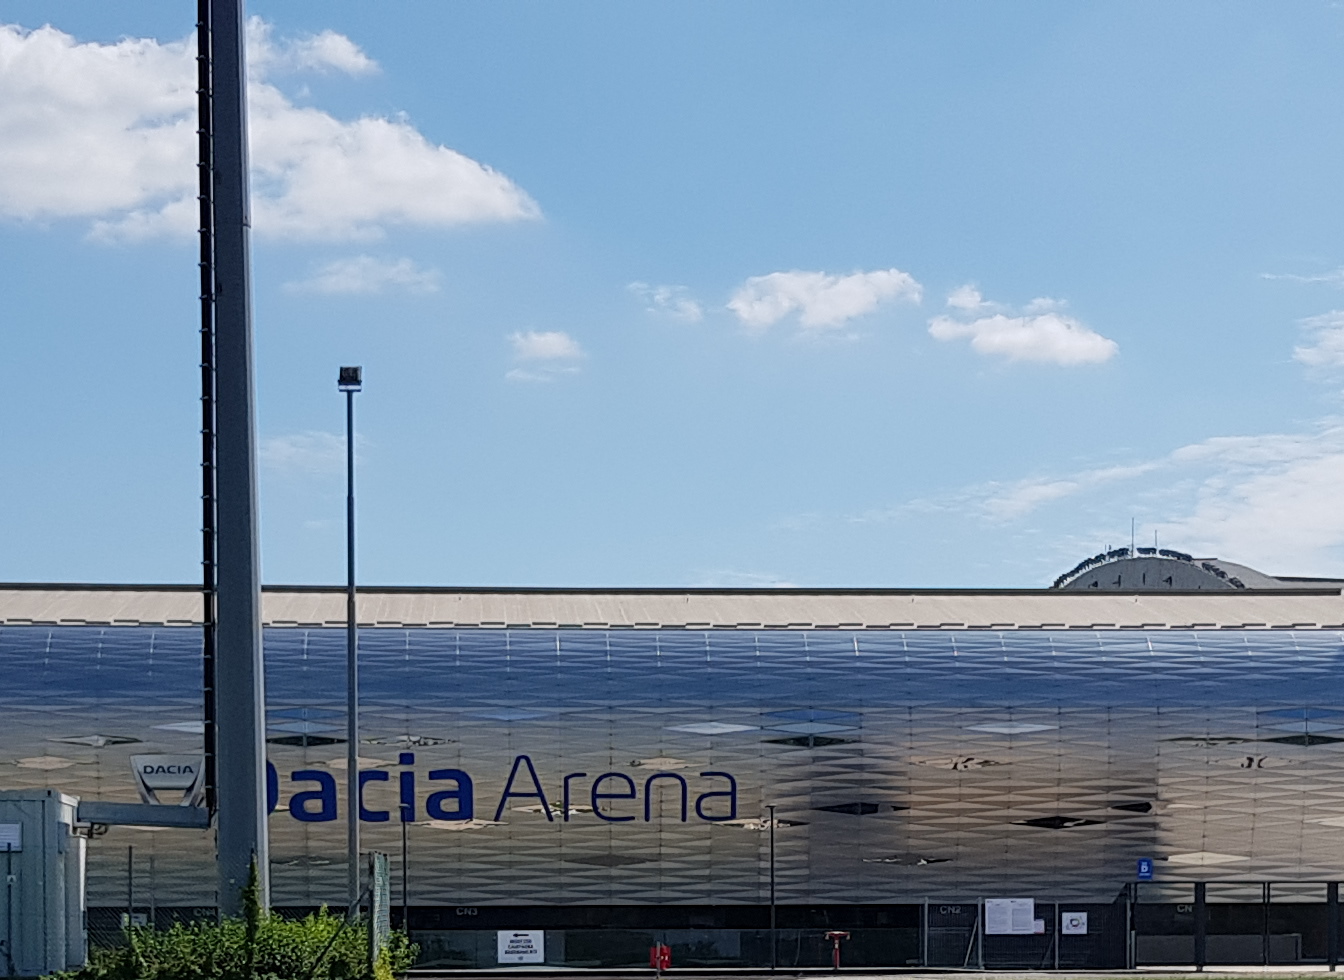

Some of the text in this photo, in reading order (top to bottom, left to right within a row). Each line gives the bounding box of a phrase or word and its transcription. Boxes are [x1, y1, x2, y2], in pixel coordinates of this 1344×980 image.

[143, 765, 194, 774] DACIA
[267, 753, 737, 822] acia Arena
[940, 905, 961, 914] CN2
